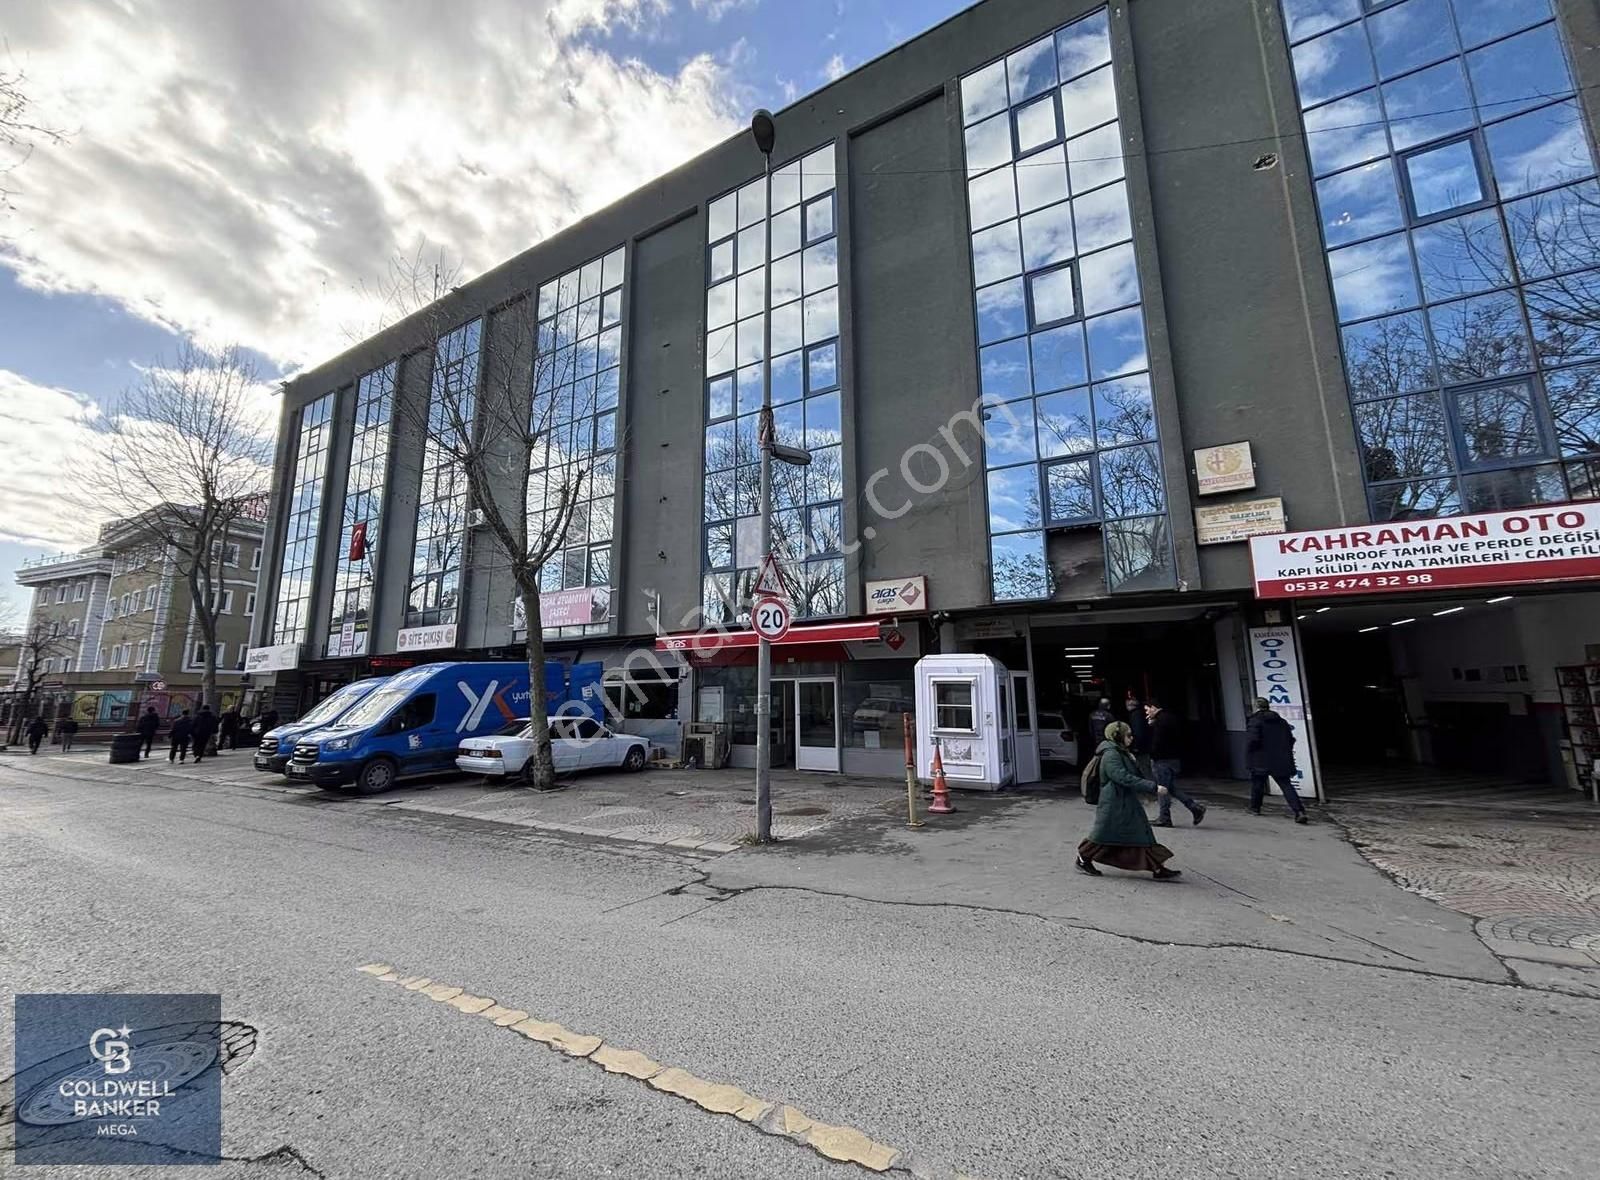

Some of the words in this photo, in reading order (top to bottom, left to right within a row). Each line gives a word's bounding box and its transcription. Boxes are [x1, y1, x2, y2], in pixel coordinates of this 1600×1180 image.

[1279, 520, 1489, 554] KAHRAMAN
[1502, 511, 1585, 533] OTO
[1314, 551, 1388, 563] SUNROOF
[1392, 543, 1442, 557] TAMİR
[1448, 542, 1469, 552] VE
[1475, 537, 1534, 550] PERDE
[1278, 567, 1311, 577] KAPI
[1315, 562, 1358, 575] KİLİDİ
[1371, 559, 1415, 570] AYNA
[1418, 550, 1510, 567] TAMİRLERİ
[1525, 548, 1564, 559] CAM
[1571, 543, 1600, 556] FİL
[1284, 581, 1329, 592] 0532
[1334, 578, 1371, 589] 474
[1376, 576, 1400, 586] 32
[1407, 574, 1432, 585] 98
[871, 587, 898, 599] aras
[760, 609, 783, 629] 20
[407, 629, 423, 646] SİTE
[666, 639, 687, 649] aras
